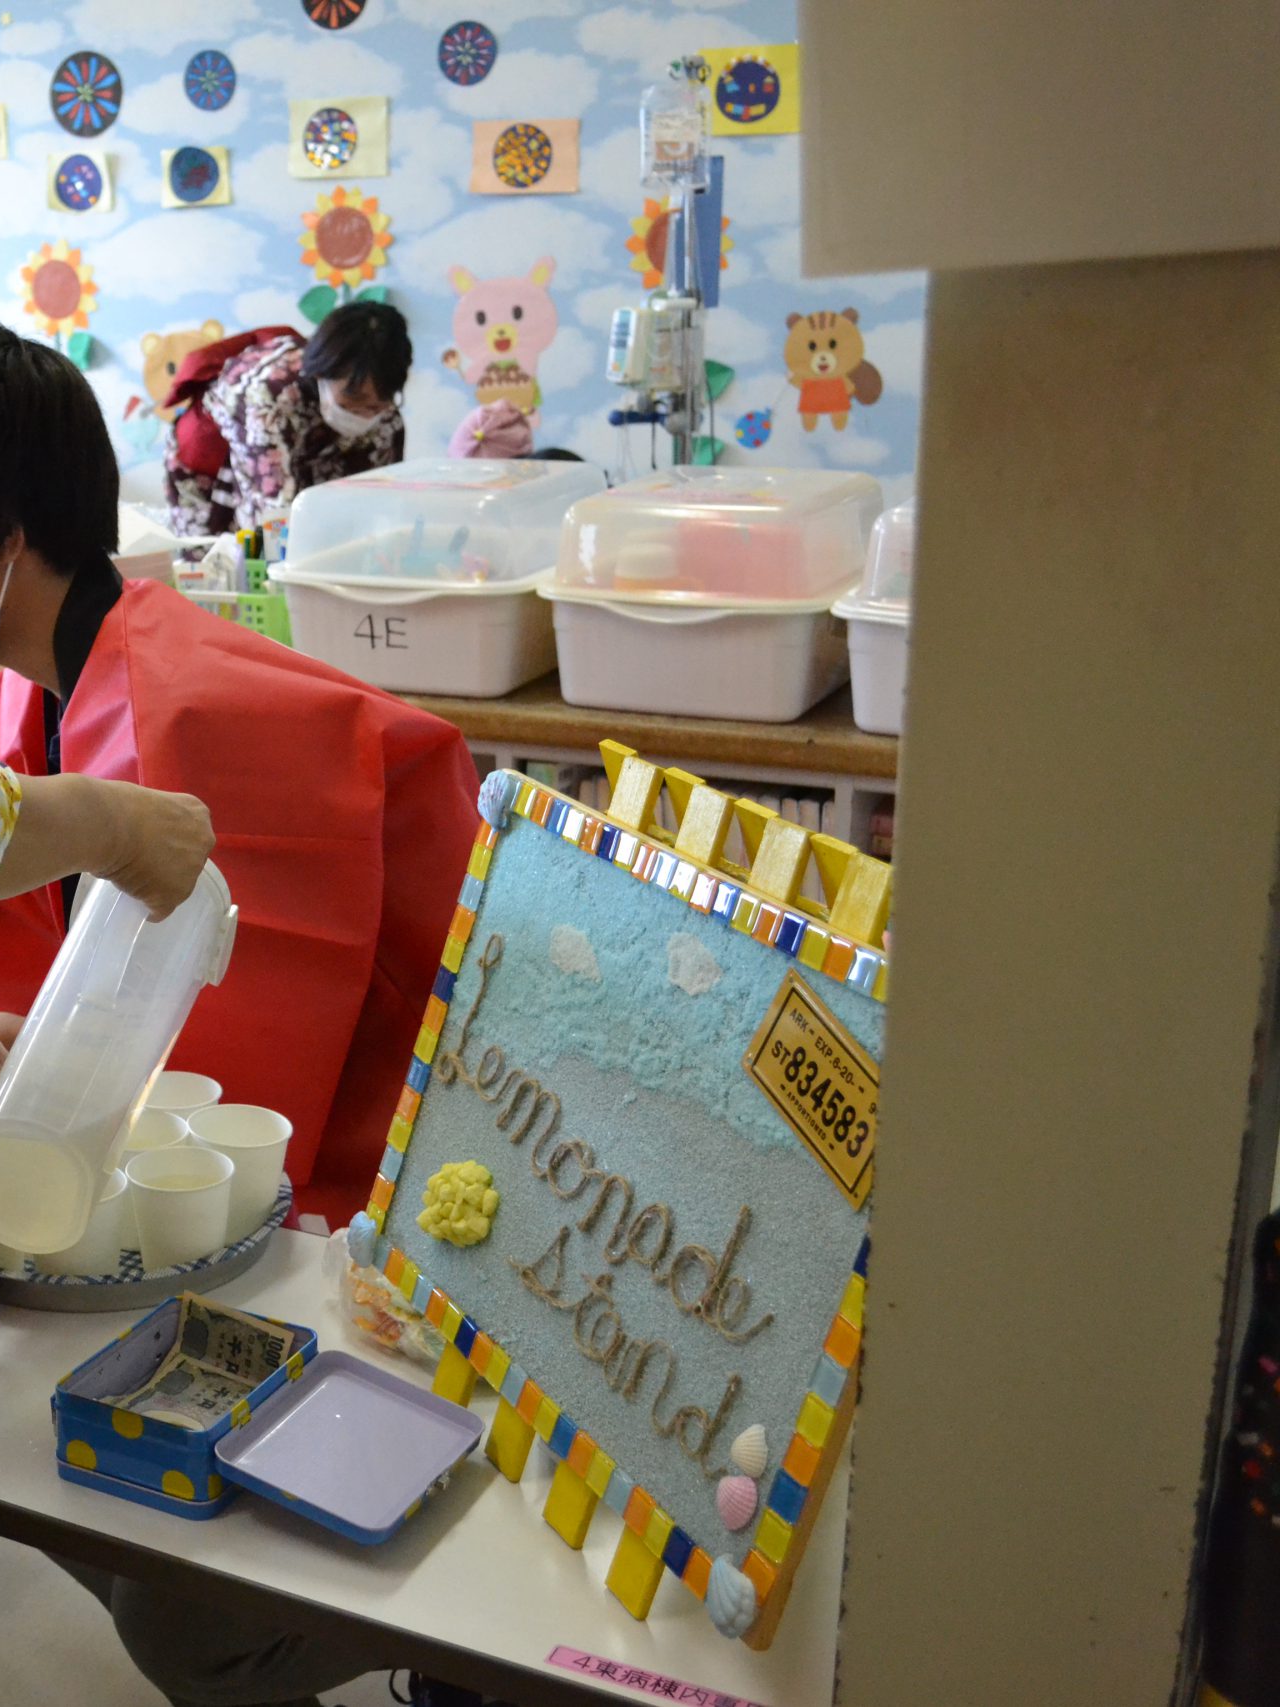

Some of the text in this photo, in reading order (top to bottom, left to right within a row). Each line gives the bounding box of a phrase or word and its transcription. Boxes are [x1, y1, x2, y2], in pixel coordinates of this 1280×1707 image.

[353, 613, 409, 650] 4E
[789, 1007, 809, 1033] ARK
[434, 933, 775, 1344] Lemonade
